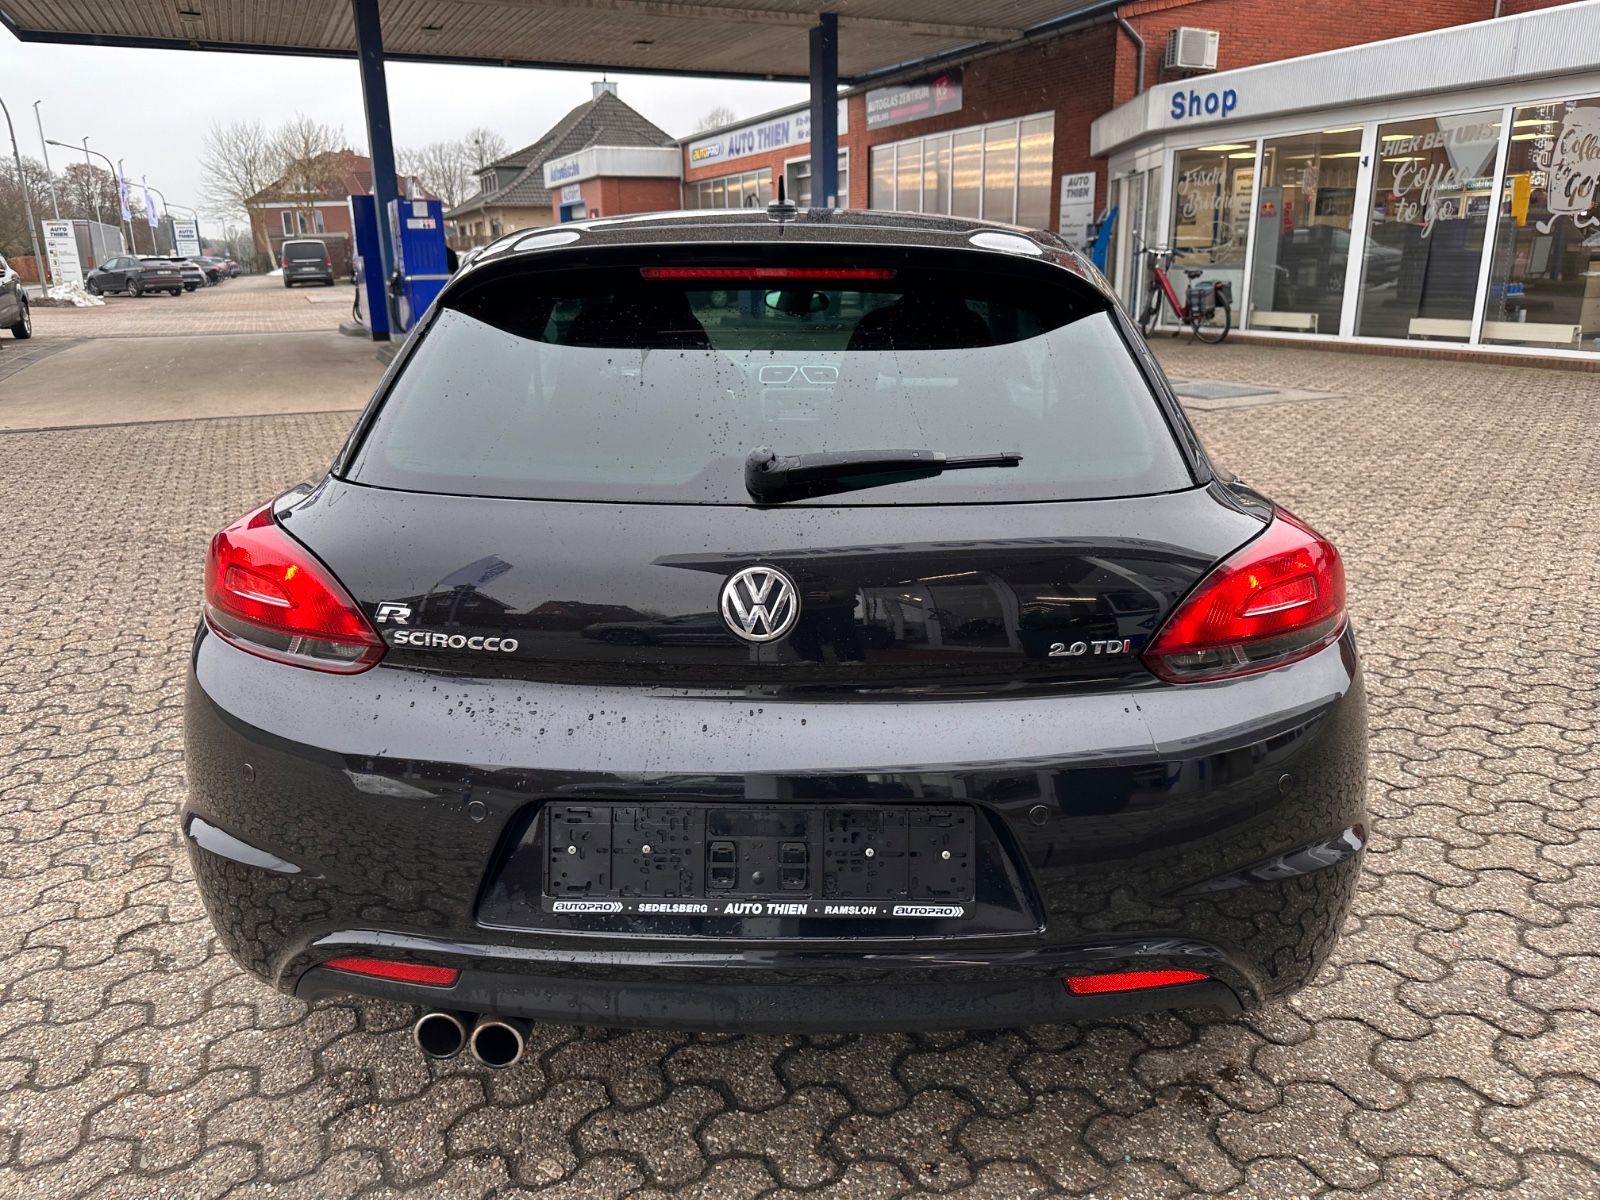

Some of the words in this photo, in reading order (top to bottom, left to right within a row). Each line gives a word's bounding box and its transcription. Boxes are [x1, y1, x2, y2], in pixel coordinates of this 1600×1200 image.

[868, 93, 898, 112] AUTOGLAS
[899, 86, 930, 104] ZENTRUM
[1171, 89, 1237, 120] Shop
[728, 131, 754, 157] AUTO
[757, 121, 790, 150] THIEN
[1384, 137, 1419, 157] HIER
[1423, 130, 1453, 150] BEI
[1455, 124, 1493, 145] UNS
[1066, 187, 1090, 198] THIEN
[1068, 175, 1089, 187] AUTO
[1393, 160, 1472, 206] Coffee
[1394, 197, 1419, 222] to
[1421, 200, 1454, 239] go
[375, 601, 412, 625] R
[393, 630, 519, 653] SCIROCCO
[1091, 639, 1131, 655] TDI
[638, 903, 708, 913] SEDELSBERG
[724, 903, 763, 915] AUTO
[767, 903, 808, 915] THIEN
[824, 905, 877, 915] RAMSLOH
